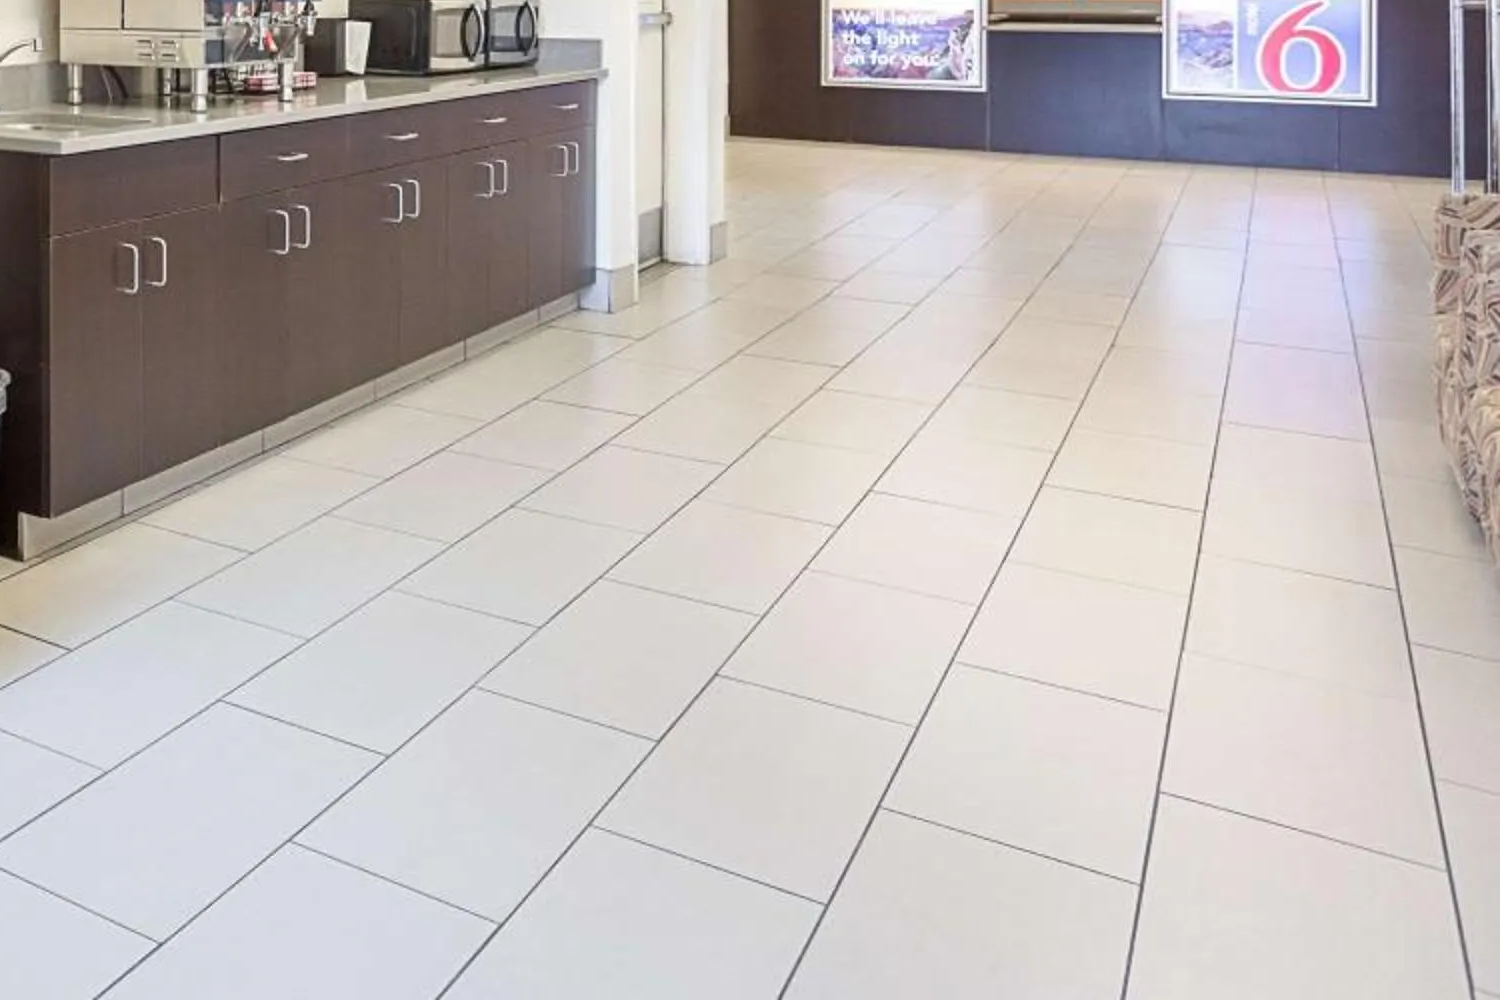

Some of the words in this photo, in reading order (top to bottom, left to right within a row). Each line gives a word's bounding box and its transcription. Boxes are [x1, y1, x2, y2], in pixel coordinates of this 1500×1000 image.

[842, 8, 886, 25] We'll
[842, 29, 873, 45] the
[877, 27, 919, 49] light
[843, 53, 866, 65] on
[871, 50, 896, 65] for
